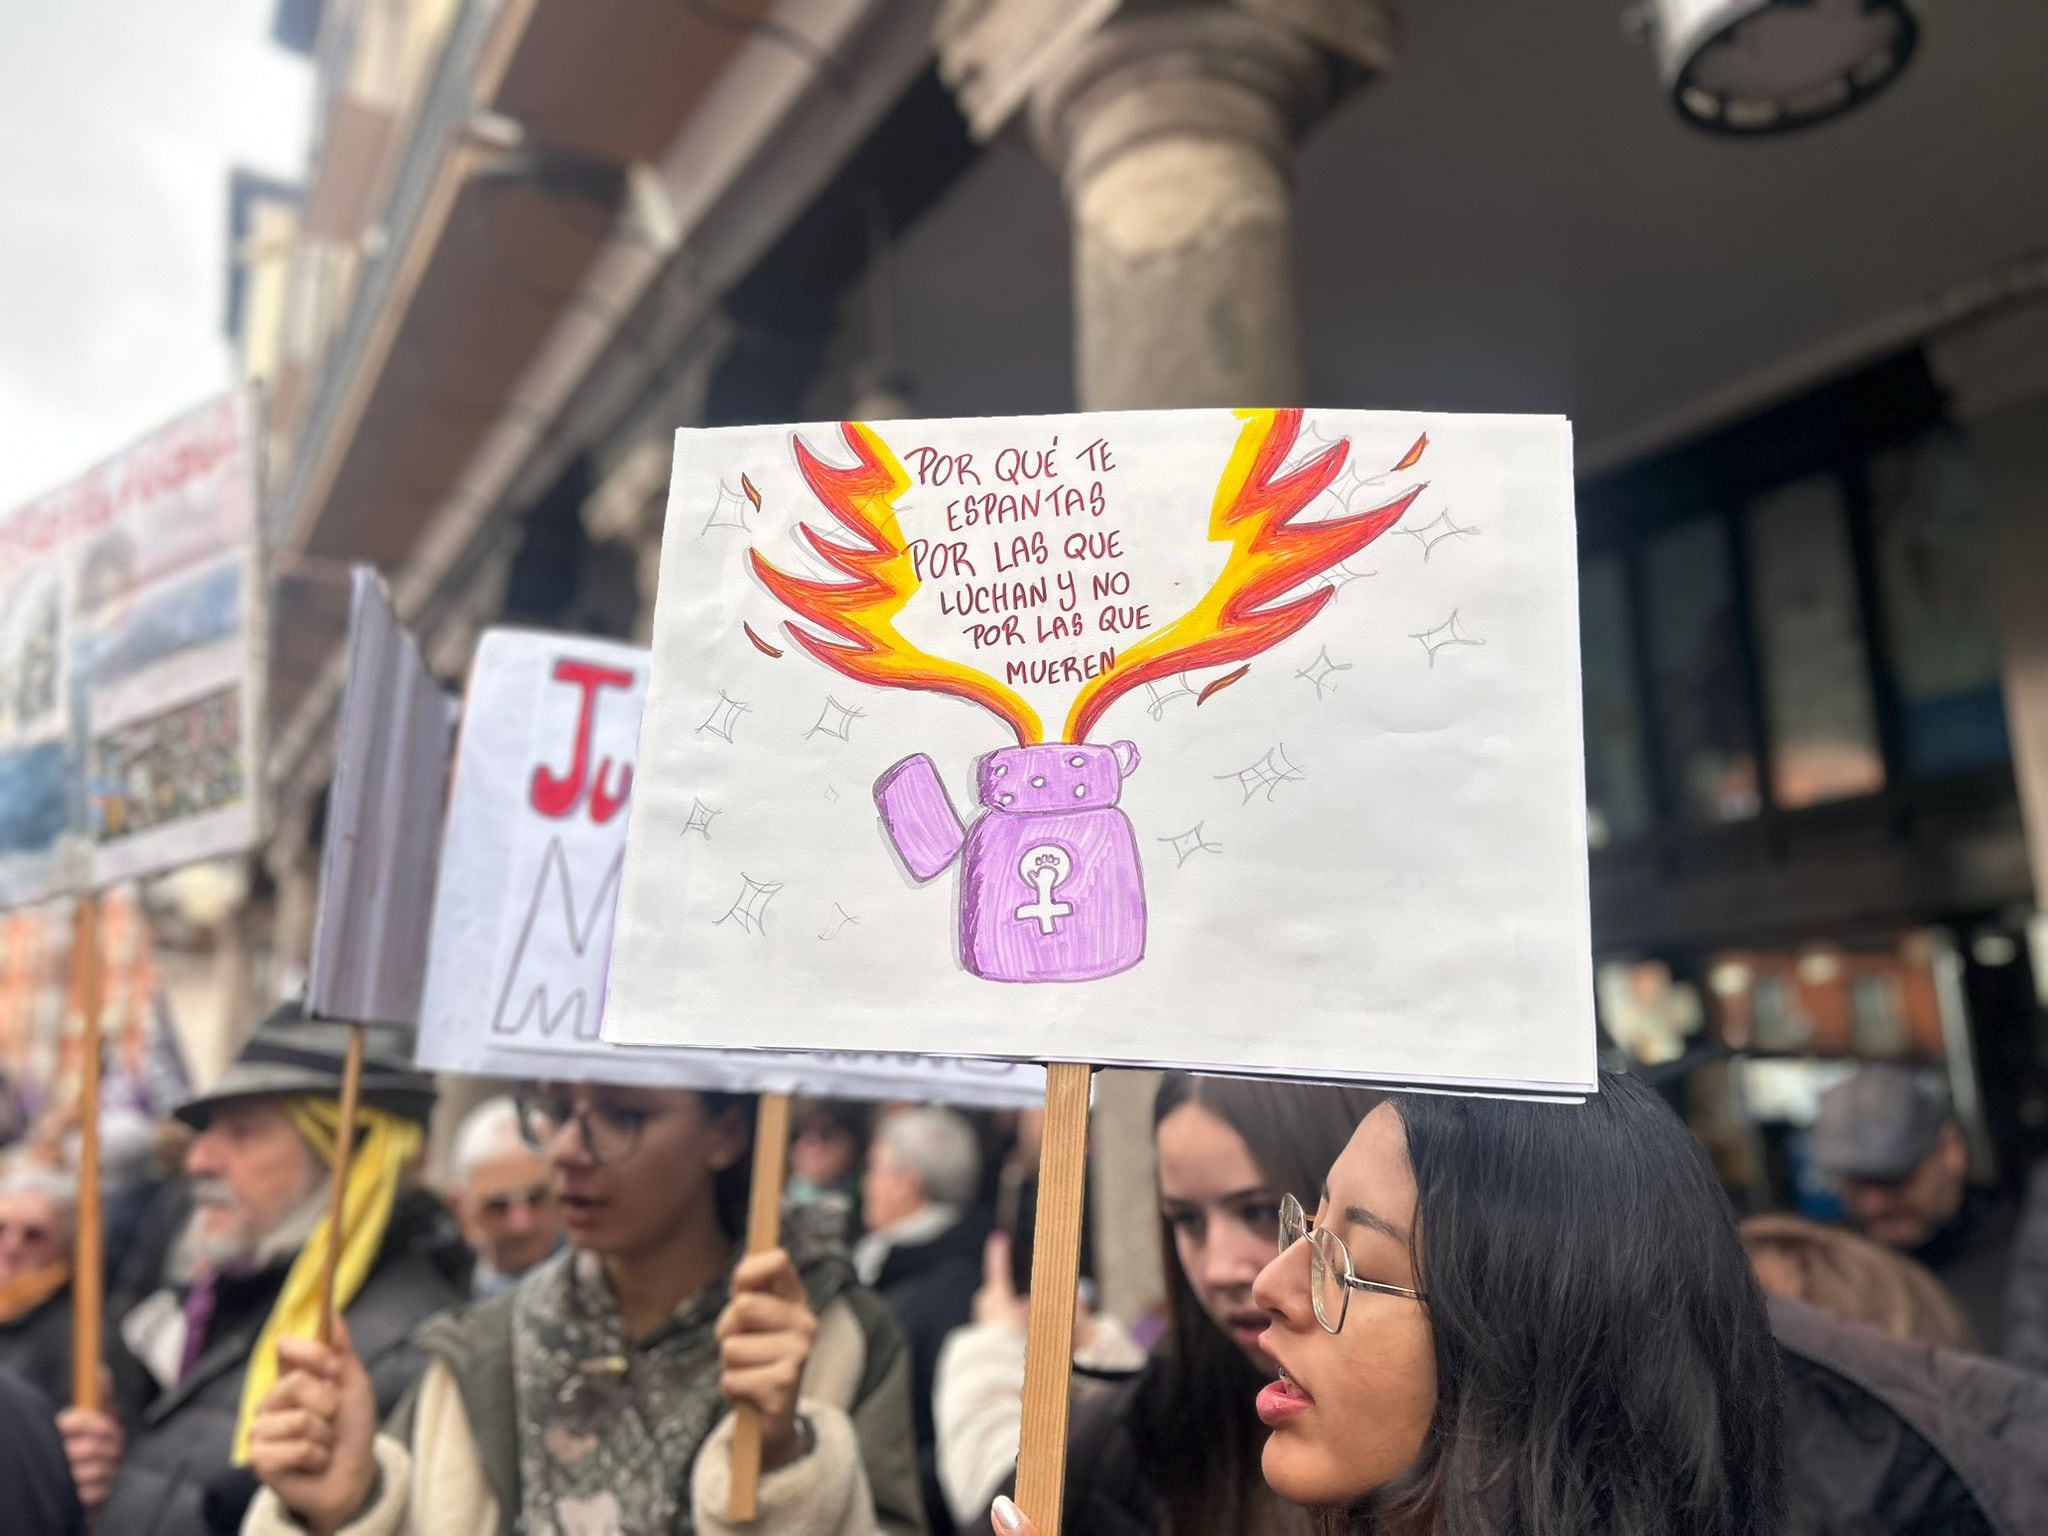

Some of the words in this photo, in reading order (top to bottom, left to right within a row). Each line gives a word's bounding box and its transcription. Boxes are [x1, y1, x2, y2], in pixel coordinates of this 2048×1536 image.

[904, 446, 981, 487] POR
[995, 436, 1058, 485] QUÉ
[1076, 438, 1116, 473] TE
[946, 481, 1106, 532] ESPANTAS
[901, 539, 976, 583] POR
[993, 531, 1048, 573] LAS
[1064, 530, 1124, 561] QUE
[940, 576, 1047, 616] LUCHAN
[1092, 571, 1130, 601] NO
[963, 615, 1026, 649] POR
[1037, 612, 1083, 643] LAS
[1099, 605, 1152, 634] QUE
[1006, 646, 1116, 685] MUEREN
